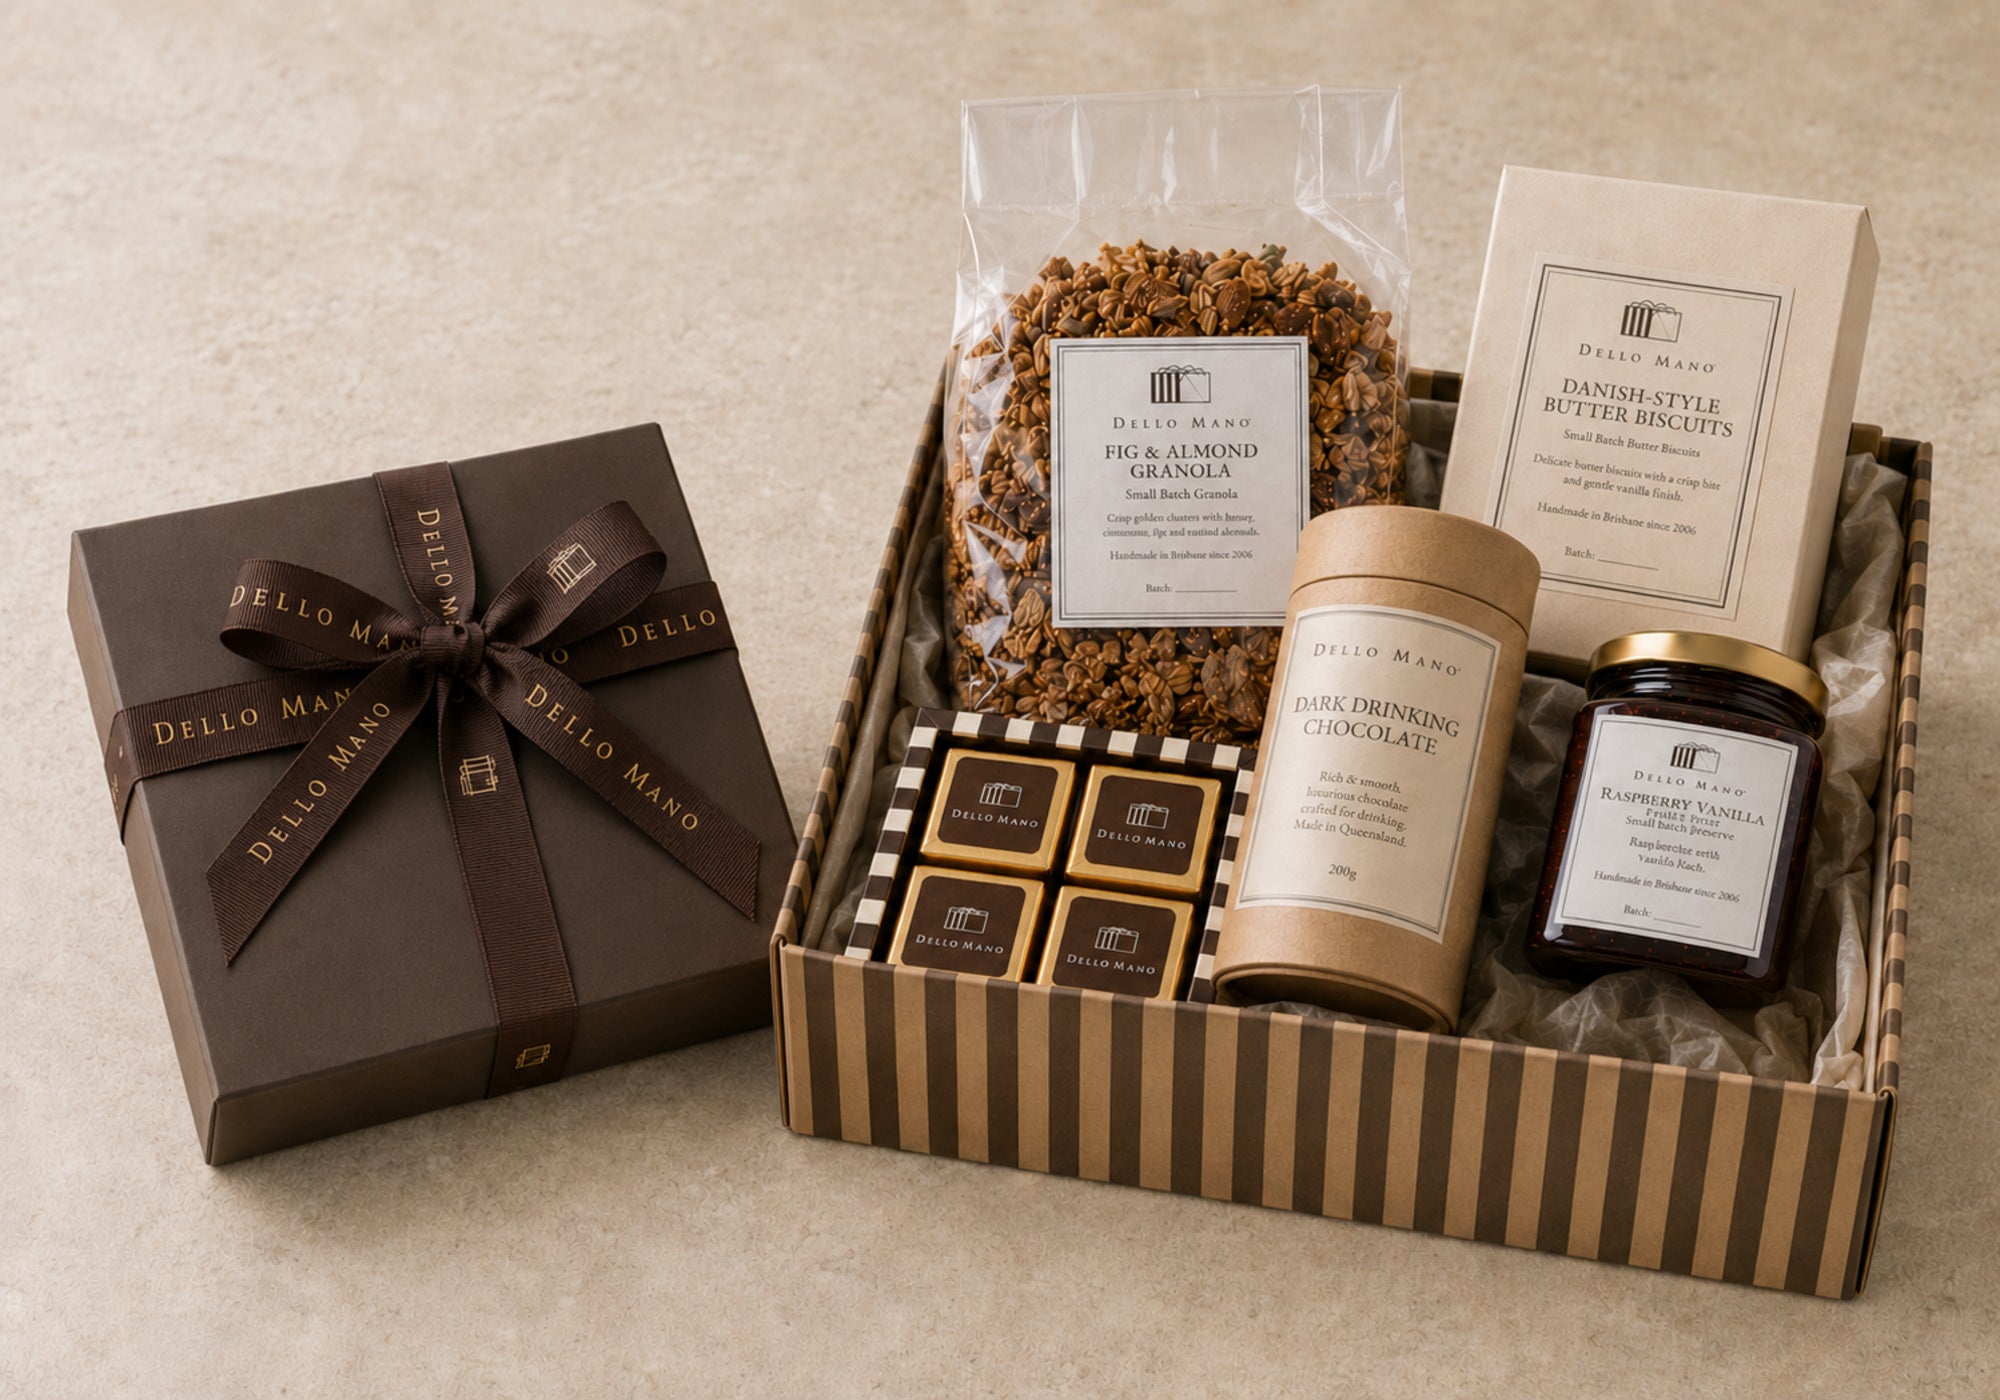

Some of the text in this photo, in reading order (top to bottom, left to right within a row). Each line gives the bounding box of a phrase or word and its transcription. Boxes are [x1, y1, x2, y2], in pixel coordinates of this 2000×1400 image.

[1579, 343, 1715, 374] DELLO MANO
[1562, 379, 1721, 415] DANISH-STYLE
[1113, 417, 1250, 429] DELLO MANO
[1543, 397, 1734, 437] BUTTER BISCUITS
[1105, 444, 1258, 459] FIG & ALMOND
[1563, 429, 1700, 458] Small Batch Butter Biscuits
[1130, 463, 1231, 479] GRANOLA
[1533, 454, 1572, 468] Delicate
[1644, 471, 1666, 482] with
[1676, 476, 1700, 489] crisp
[1702, 479, 1721, 490] bite
[1126, 488, 1238, 499] Small Batch Granola
[1563, 476, 1582, 486] and
[1584, 479, 1614, 492] gentle
[1617, 484, 1649, 496] vanilla
[1107, 513, 1131, 524] Crisp
[1134, 513, 1164, 525] golden
[1166, 513, 1199, 522] clusters
[1202, 513, 1222, 522] with
[1537, 502, 1696, 535] Handmade in Brisbane since 2006
[417, 508, 453, 586] DELLO
[1110, 550, 1253, 560] Handmade in Brisbane since 2006
[1564, 546, 1595, 561] Batch:
[1146, 584, 1172, 593] Batch:
[229, 585, 333, 626] DELLO
[618, 609, 716, 647] DELLO
[1313, 643, 1458, 677] DELLO MANO
[152, 688, 350, 745] DELLO MAN
[1294, 696, 1459, 737] DARK DRINKING
[1303, 719, 1438, 755] CHOCOLATE
[524, 683, 698, 830] DELLO MANO
[246, 702, 390, 864] DELLO MANO
[1320, 771, 1343, 783] Rich
[1346, 775, 1357, 784] &
[1634, 770, 1744, 797] DELLO MANO
[1301, 804, 1337, 815] crafted
[1339, 806, 1355, 817] for
[1358, 793, 1408, 813] chocolate
[1601, 787, 1692, 811] RASPBERRY
[1698, 801, 1765, 826] VANILLA
[952, 808, 1038, 829] DELLO MANO
[1625, 815, 1655, 828] Small
[1097, 828, 1186, 850] DELLO MANO
[1293, 819, 1406, 847] Made in Queensland.
[1329, 864, 1357, 881] 200g
[1594, 870, 1641, 887] Handmade
[1643, 879, 1653, 888] in
[1718, 891, 1740, 903] 2006
[915, 934, 1004, 954] DELLO MANO
[1067, 953, 1155, 975] DELLO MANO
